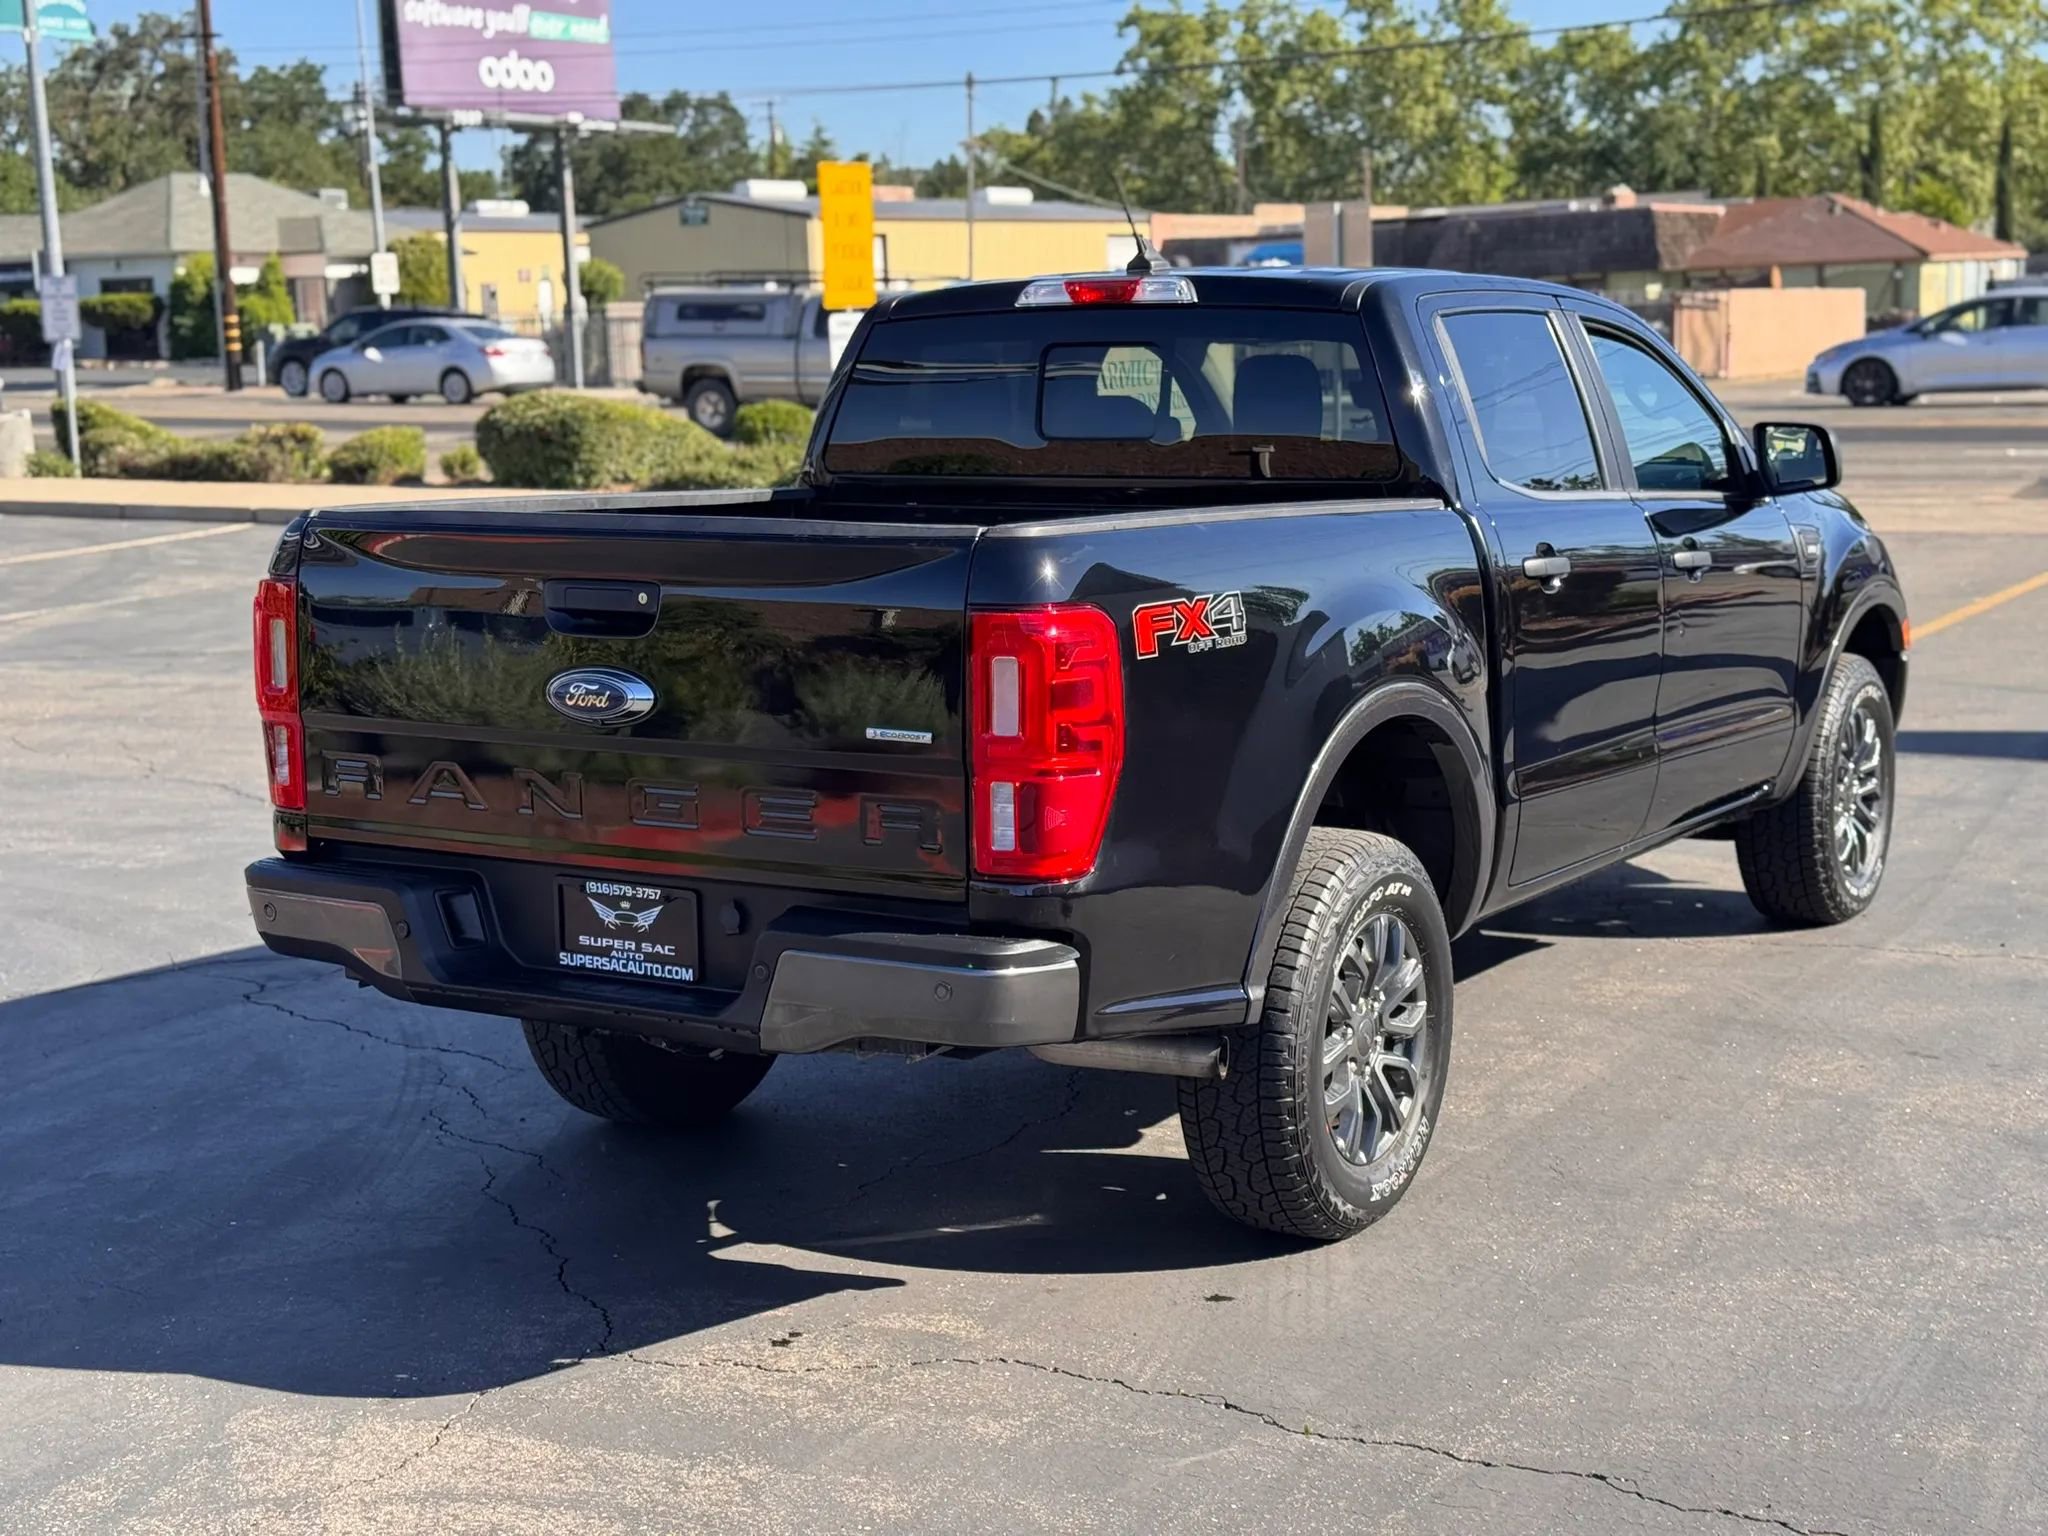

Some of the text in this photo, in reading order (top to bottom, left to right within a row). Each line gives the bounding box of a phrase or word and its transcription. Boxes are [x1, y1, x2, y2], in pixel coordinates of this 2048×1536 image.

[478, 49, 555, 92] odoo
[1132, 590, 1246, 660] FX4
[1188, 634, 1247, 654] OFF ROAD
[565, 682, 610, 708] Ford
[321, 750, 943, 854] RANGER
[586, 881, 661, 900] (916)579-3757
[578, 935, 676, 956] SUPER SAC
[610, 950, 644, 961] AUTO
[559, 952, 694, 981] SUPERSACAUTO.COM
